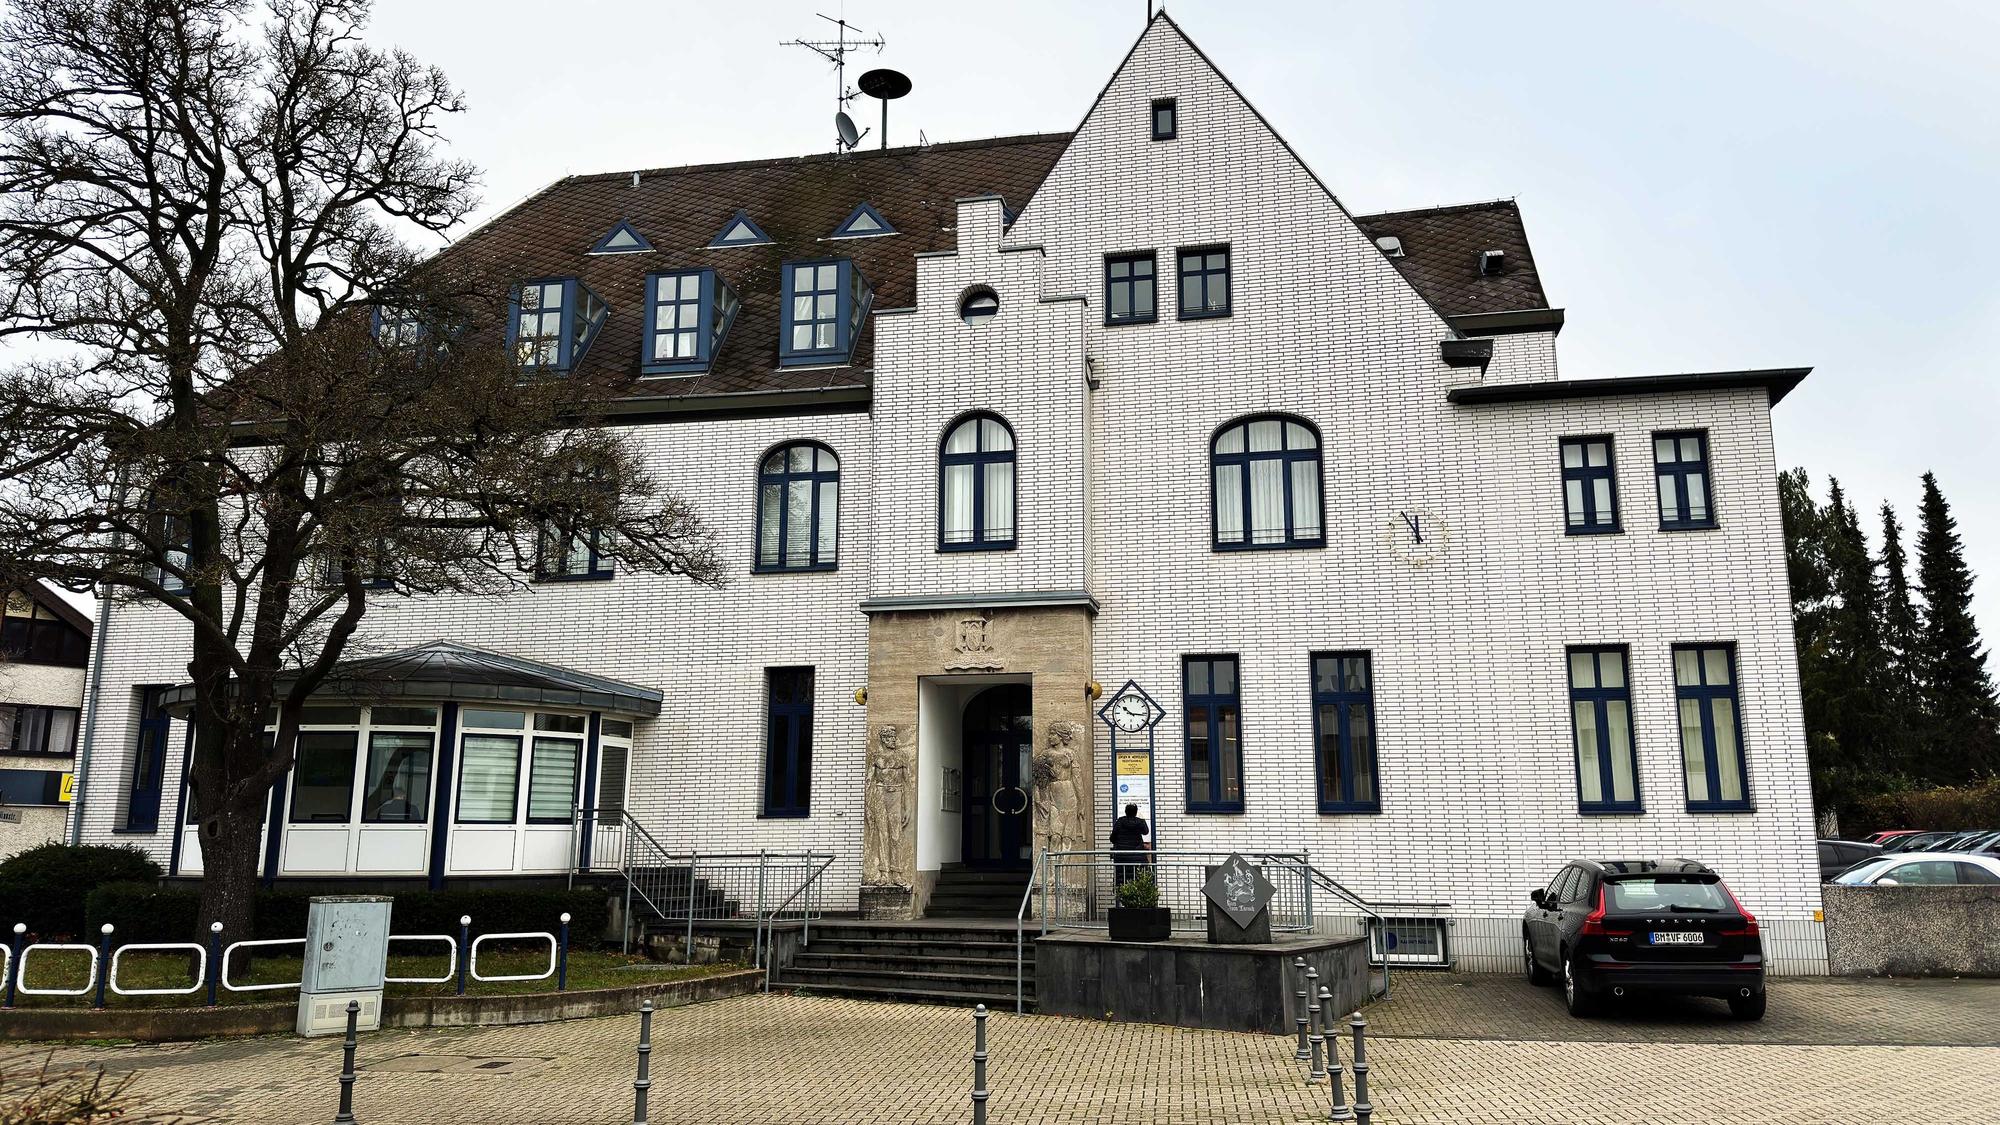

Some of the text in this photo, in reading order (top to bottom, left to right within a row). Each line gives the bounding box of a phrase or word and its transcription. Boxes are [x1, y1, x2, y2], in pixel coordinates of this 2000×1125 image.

[1655, 933, 1703, 942] BM VF 6006
